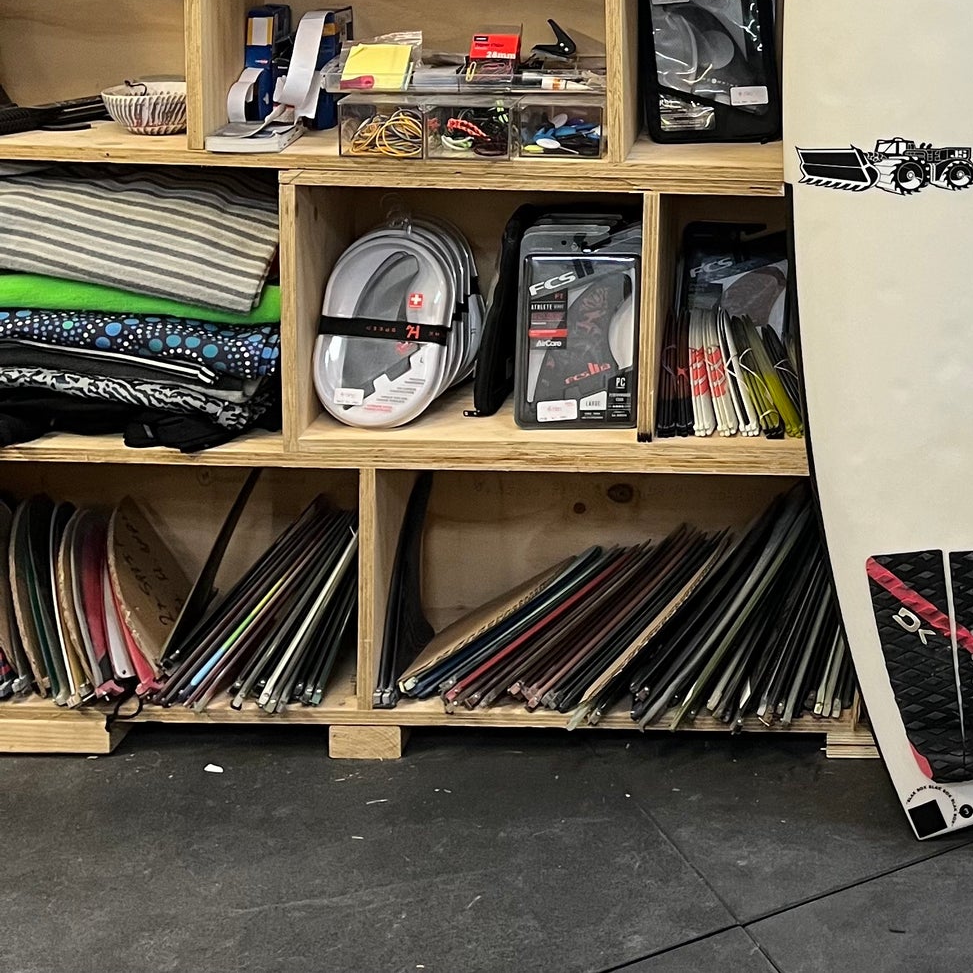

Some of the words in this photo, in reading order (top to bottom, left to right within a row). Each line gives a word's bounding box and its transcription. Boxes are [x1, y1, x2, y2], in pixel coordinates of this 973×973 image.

[486, 51, 516, 59] 28mm
[689, 257, 733, 278] FCS
[529, 271, 576, 297] FCS
[615, 377, 626, 387] PC
